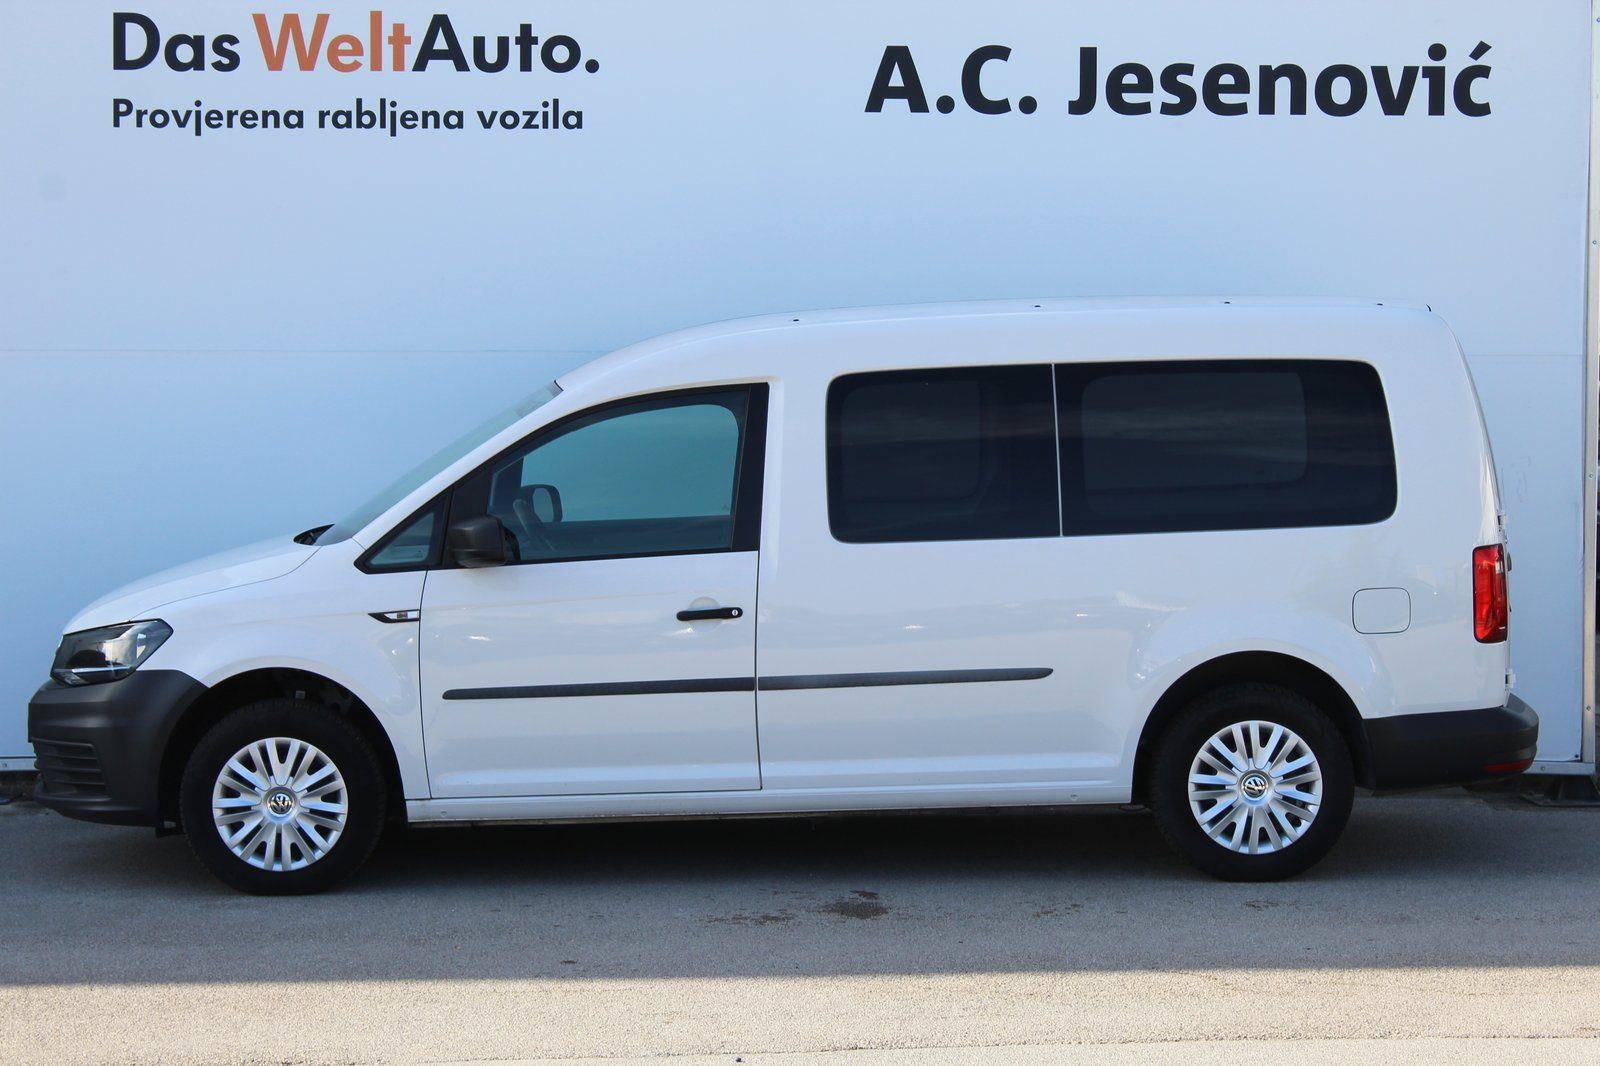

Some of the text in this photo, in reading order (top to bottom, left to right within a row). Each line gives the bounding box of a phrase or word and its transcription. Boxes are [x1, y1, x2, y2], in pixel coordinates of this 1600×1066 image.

[112, 11, 600, 73] Das WeltAuto.
[864, 40, 1492, 117] A.C. Jesenović
[112, 97, 583, 137] Provjerena rabljena vozila
